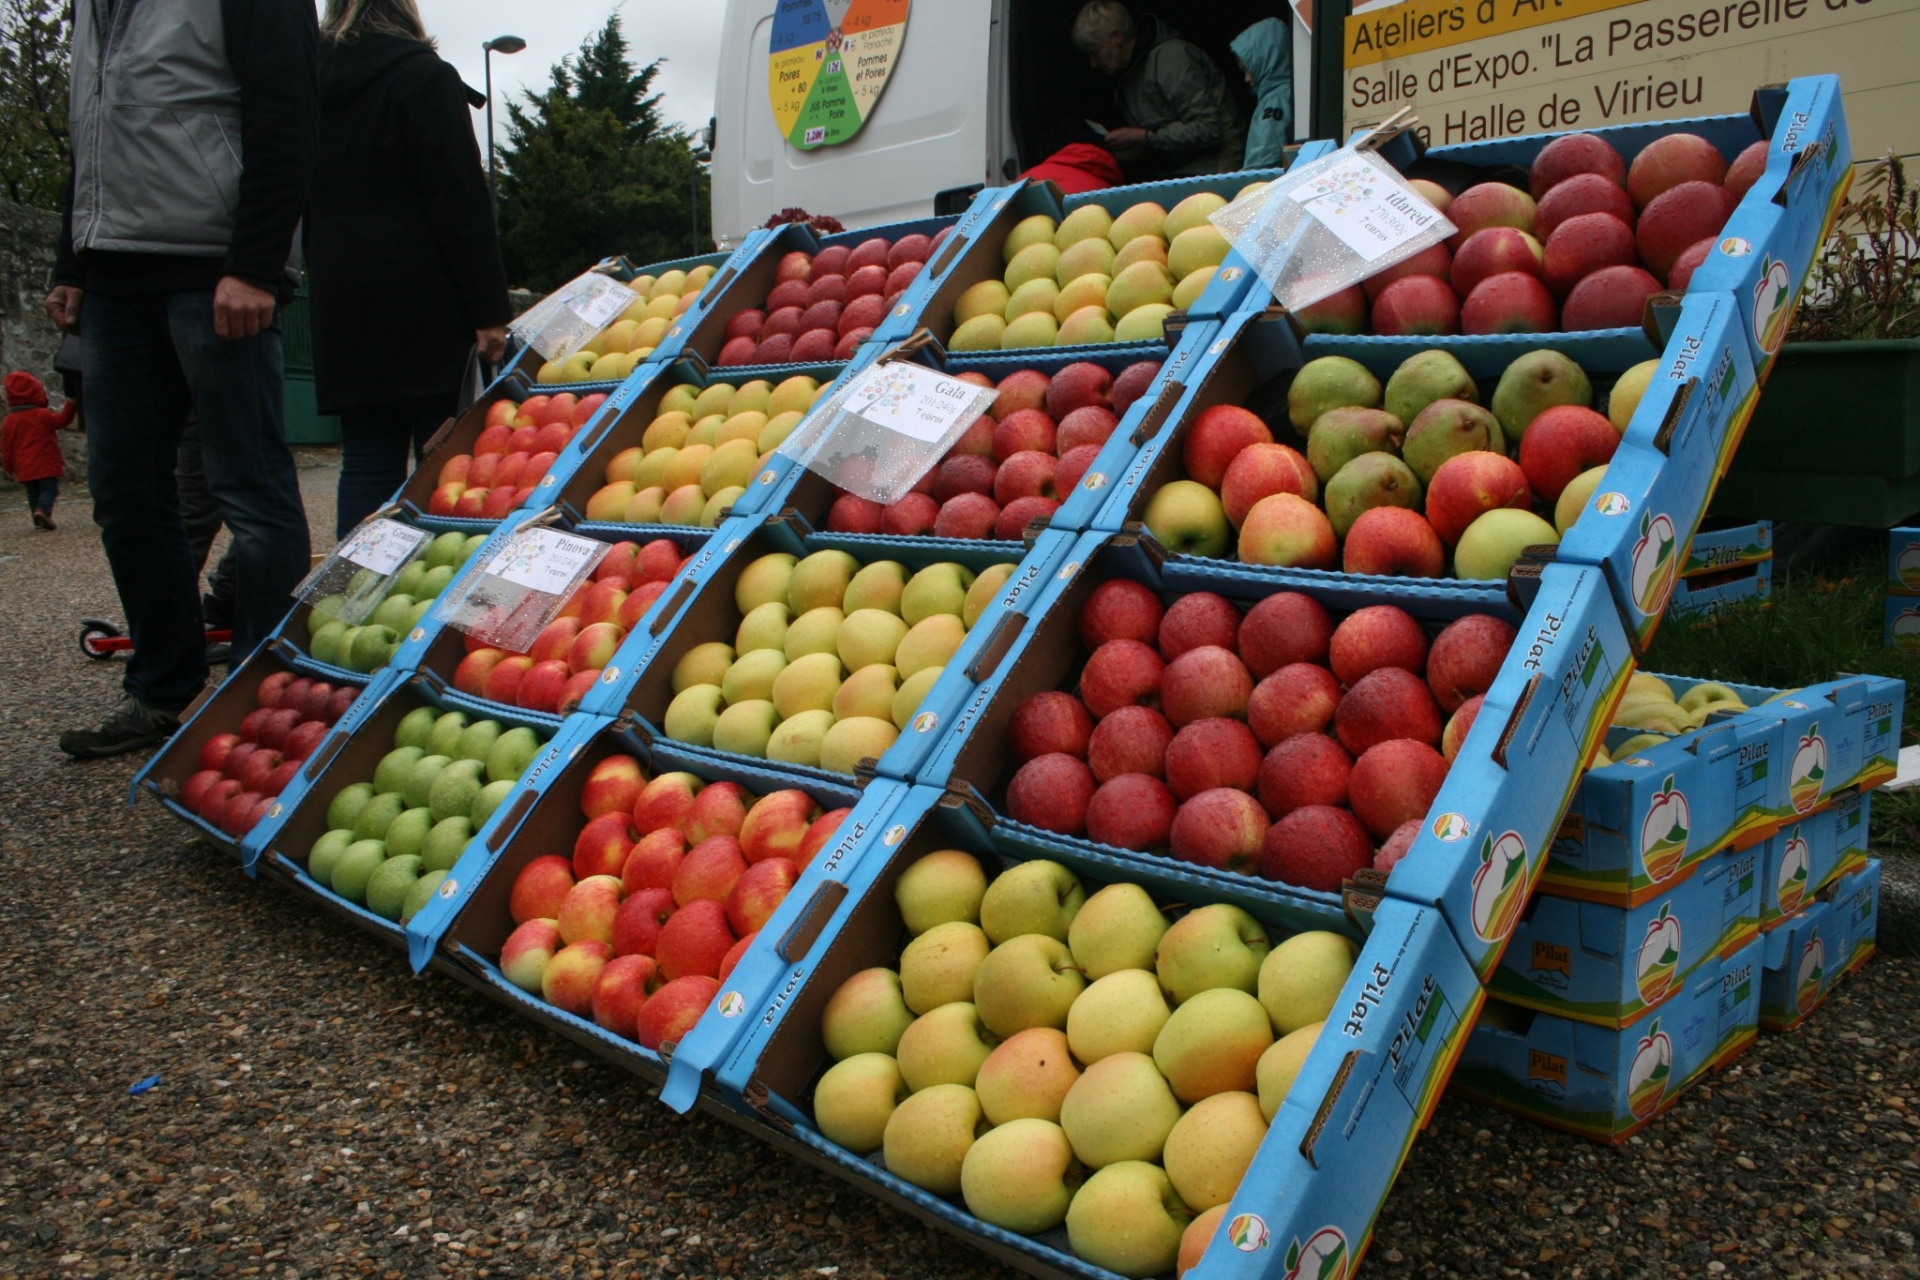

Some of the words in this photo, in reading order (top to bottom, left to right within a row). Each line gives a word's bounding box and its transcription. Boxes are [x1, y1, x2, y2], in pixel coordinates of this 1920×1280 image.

[1352, 6, 1465, 54] Ateliers
[781, 55, 805, 69] plateau
[857, 53, 888, 68] Pommes
[1351, 71, 1417, 108] Salle
[1428, 50, 1537, 93] d'Expo.
[1541, 33, 1593, 68] "La
[1607, 0, 1808, 56] Passerelle
[779, 69, 801, 83] Poires
[797, 82, 807, 94] 80
[856, 72, 864, 81] et
[864, 67, 886, 80] Poires
[810, 101, 820, 112] JUS
[821, 97, 846, 109] Pomme
[861, 85, 868, 96] 5
[869, 84, 880, 97] kg
[783, 101, 789, 112] 5
[790, 100, 800, 112] kg
[829, 109, 845, 120] Poire
[1262, 107, 1284, 121] 20
[1445, 103, 1525, 145] Halle
[1538, 94, 1580, 129] de
[1594, 75, 1703, 118] Virieu
[1782, 112, 1809, 153] Pilat
[1385, 191, 1433, 227] Idared
[1358, 216, 1368, 224] 7
[1364, 222, 1389, 242] euros
[1669, 335, 1701, 382] Pilat
[935, 381, 966, 400] Gala
[1706, 344, 1732, 411] Pilat
[914, 408, 922, 417] 7
[920, 412, 945, 423] euros
[1126, 444, 1157, 488] Pilat
[555, 537, 591, 557] Pinova
[1704, 544, 1742, 569] Pilat
[1002, 564, 1039, 608] Pilat
[1523, 611, 1562, 671] Pilat
[1563, 625, 1599, 704] Pilat
[956, 684, 992, 735] Pilat
[1867, 701, 1893, 721] Pilat
[525, 746, 559, 786] Pilat
[1738, 740, 1769, 767] Pilat
[824, 821, 866, 873] Pilat
[1727, 854, 1756, 884] Pilat
[1535, 940, 1570, 965] Pilat
[1722, 962, 1752, 994] Pilat
[764, 967, 806, 1027] Pilat
[1342, 961, 1391, 1037] Pilat
[1391, 972, 1438, 1073] Pilat
[1531, 1052, 1566, 1075] Pilat
